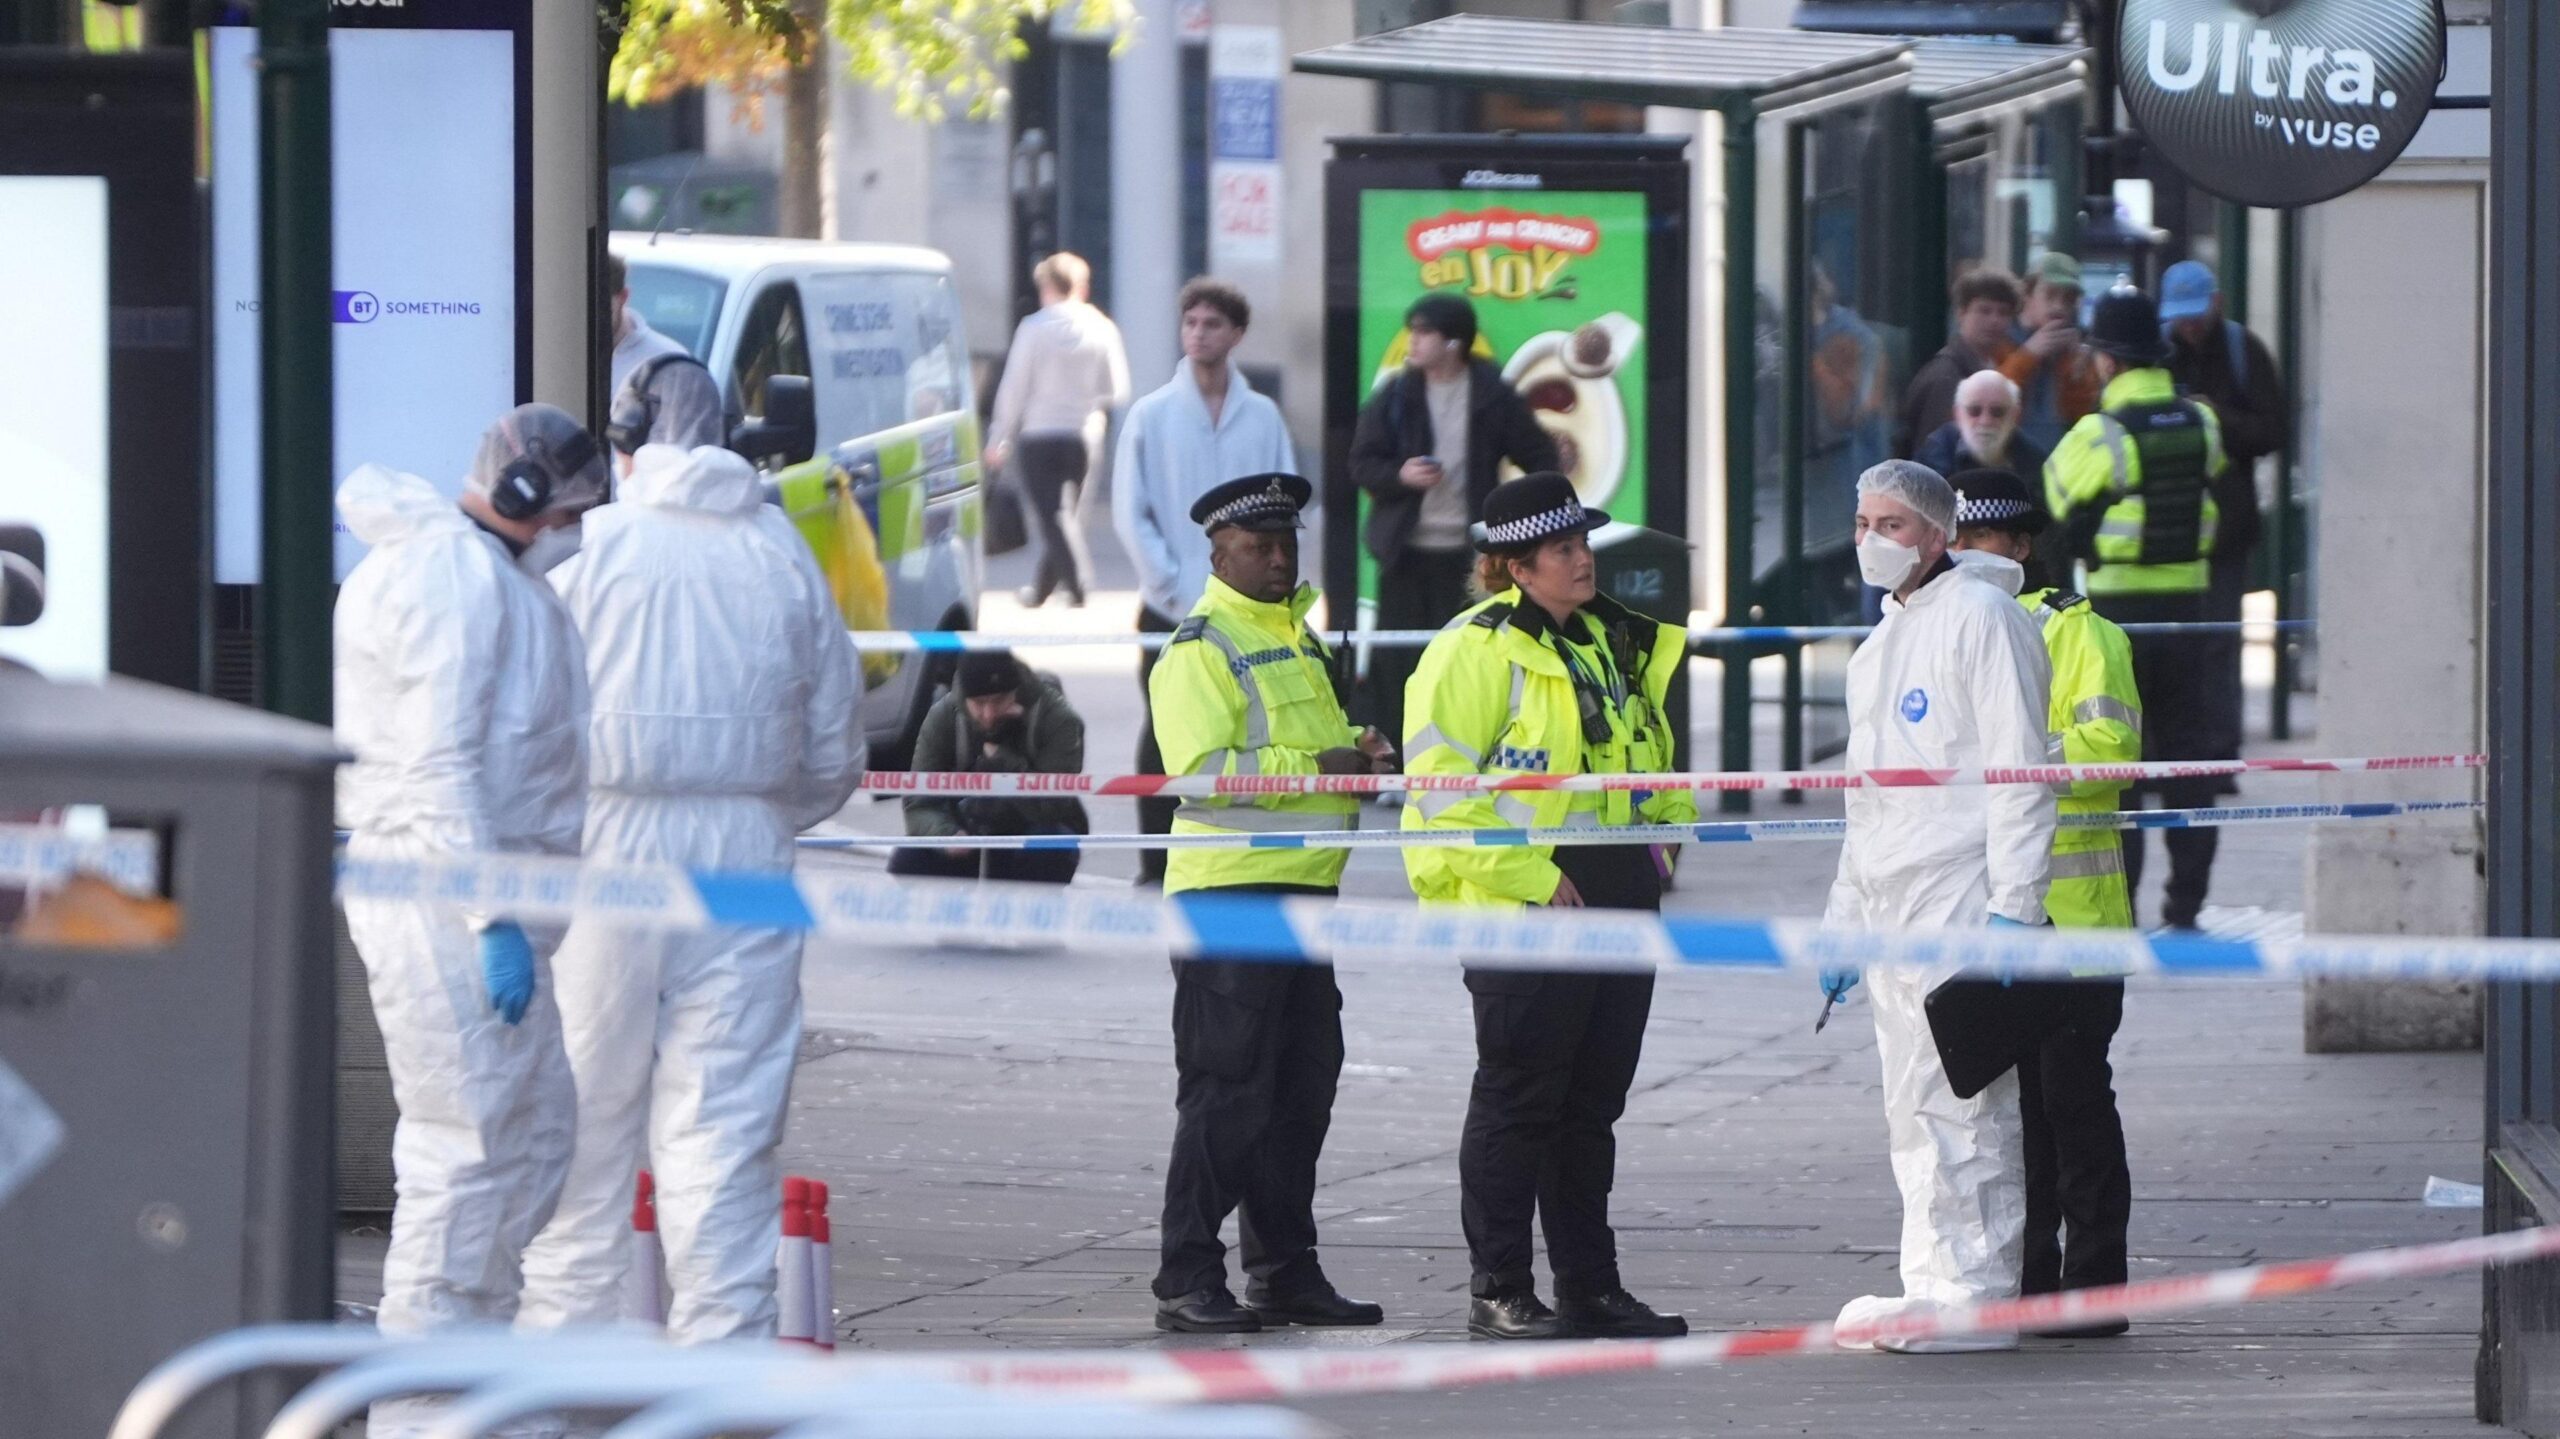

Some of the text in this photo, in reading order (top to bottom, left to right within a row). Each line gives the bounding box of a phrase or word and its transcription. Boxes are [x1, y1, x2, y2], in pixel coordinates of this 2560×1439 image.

[2147, 18, 2398, 108] Ultra.
[2255, 111, 2274, 128] by
[1418, 220, 1484, 250] CREAMY
[1517, 219, 1592, 247] CRUNCHY
[353, 301, 373, 314] BT
[386, 301, 481, 315] SOMETHING
